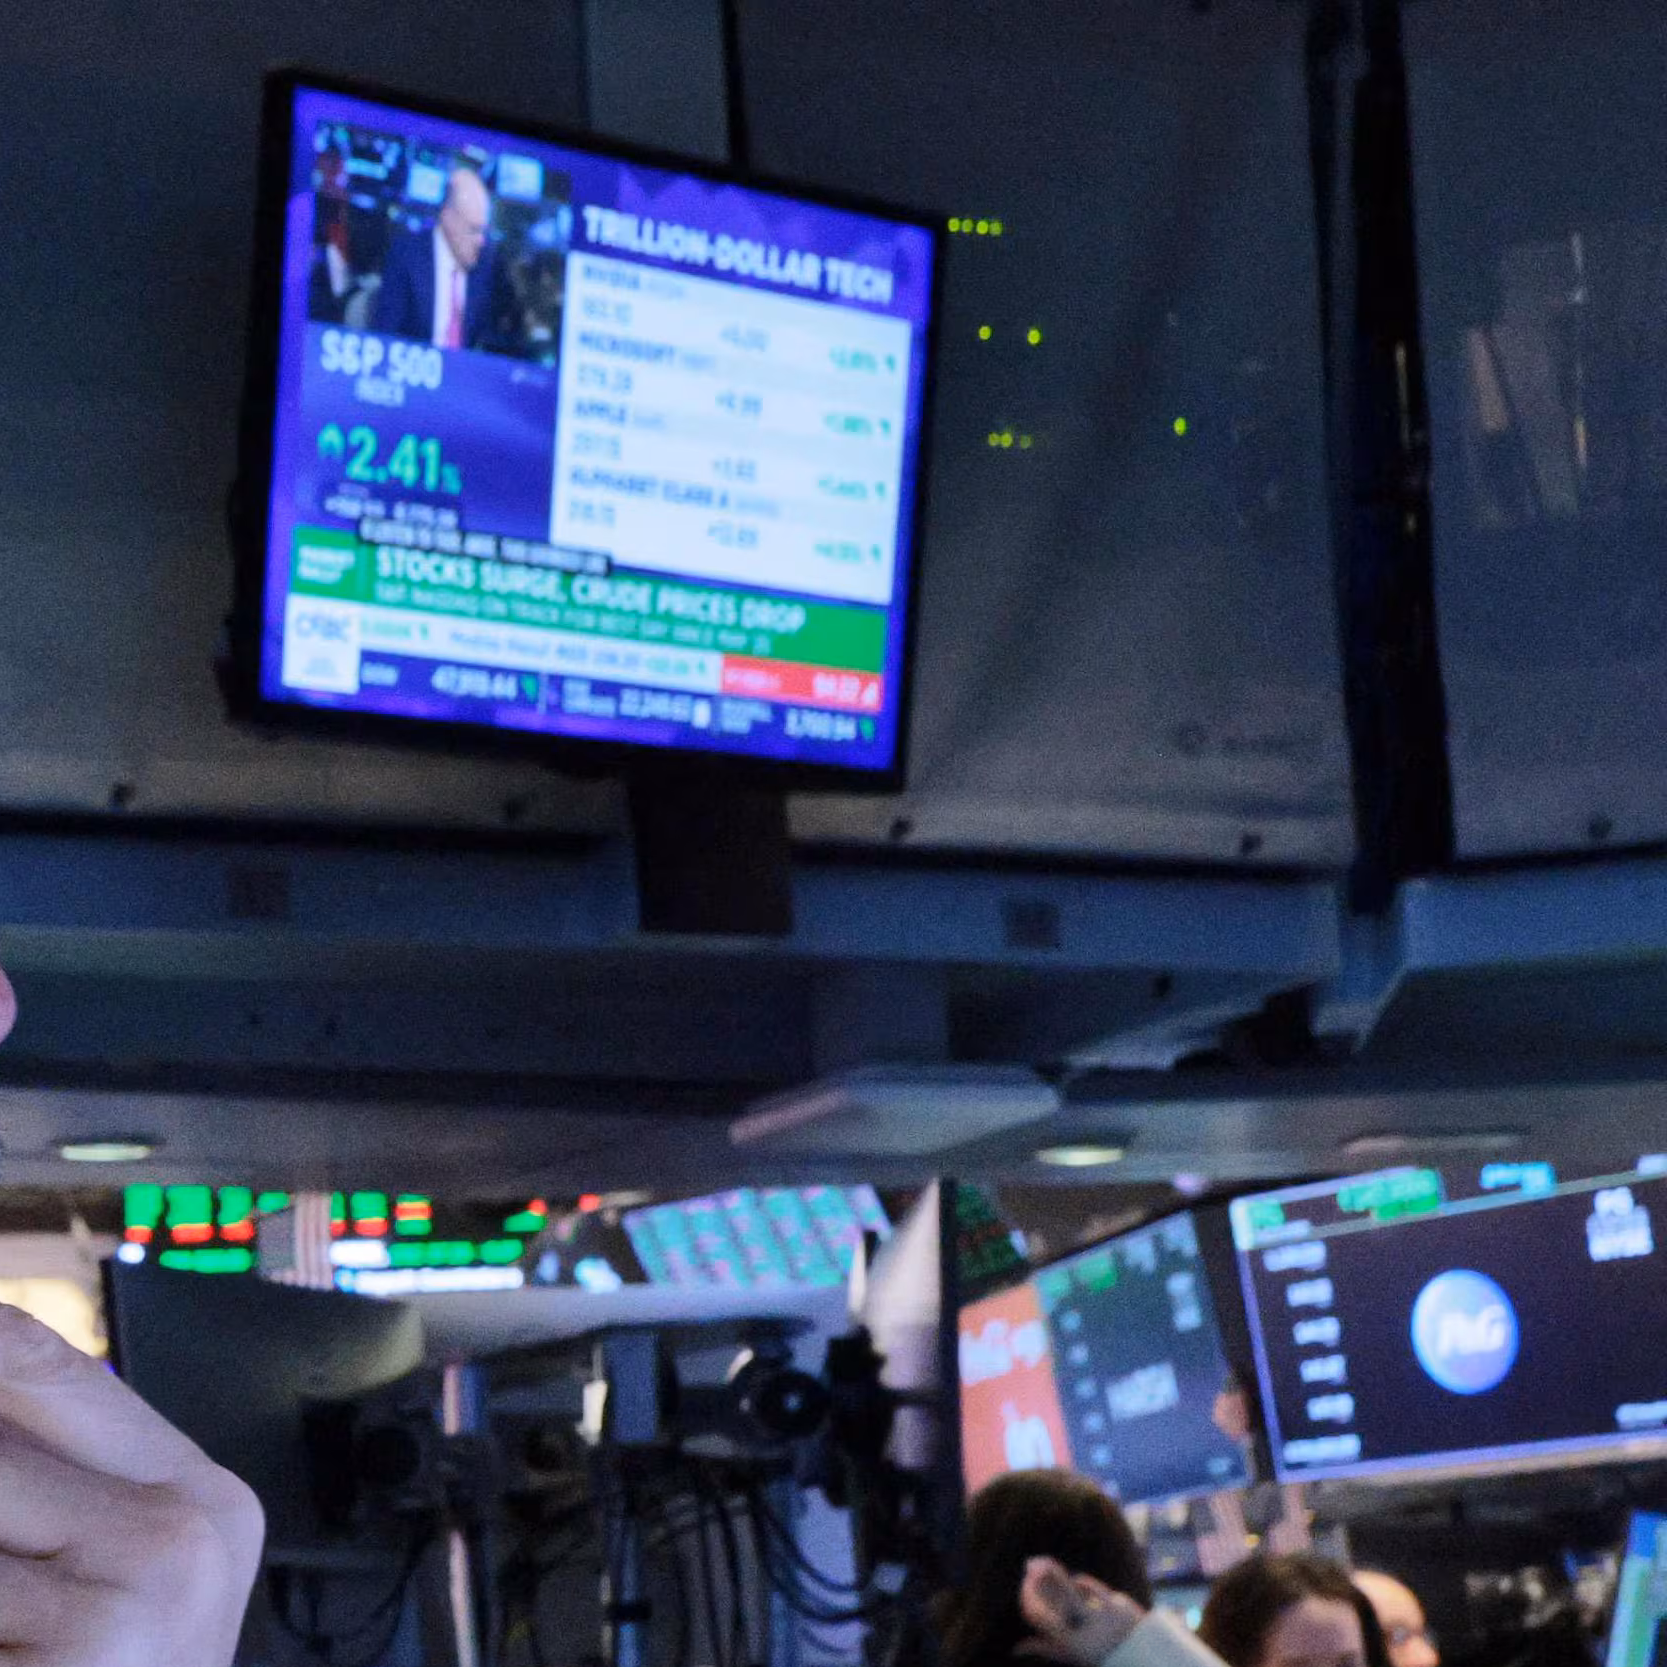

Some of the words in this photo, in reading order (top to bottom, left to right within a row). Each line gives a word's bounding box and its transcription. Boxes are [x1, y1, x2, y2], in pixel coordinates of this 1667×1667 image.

[583, 205, 820, 290] TRILLION-DOLLAR
[823, 257, 894, 305] TECH
[321, 329, 381, 381] S&P
[385, 339, 443, 389] 500
[376, 546, 475, 590] STOCKS
[659, 585, 737, 626] PRICES
[741, 598, 806, 632] DROP
